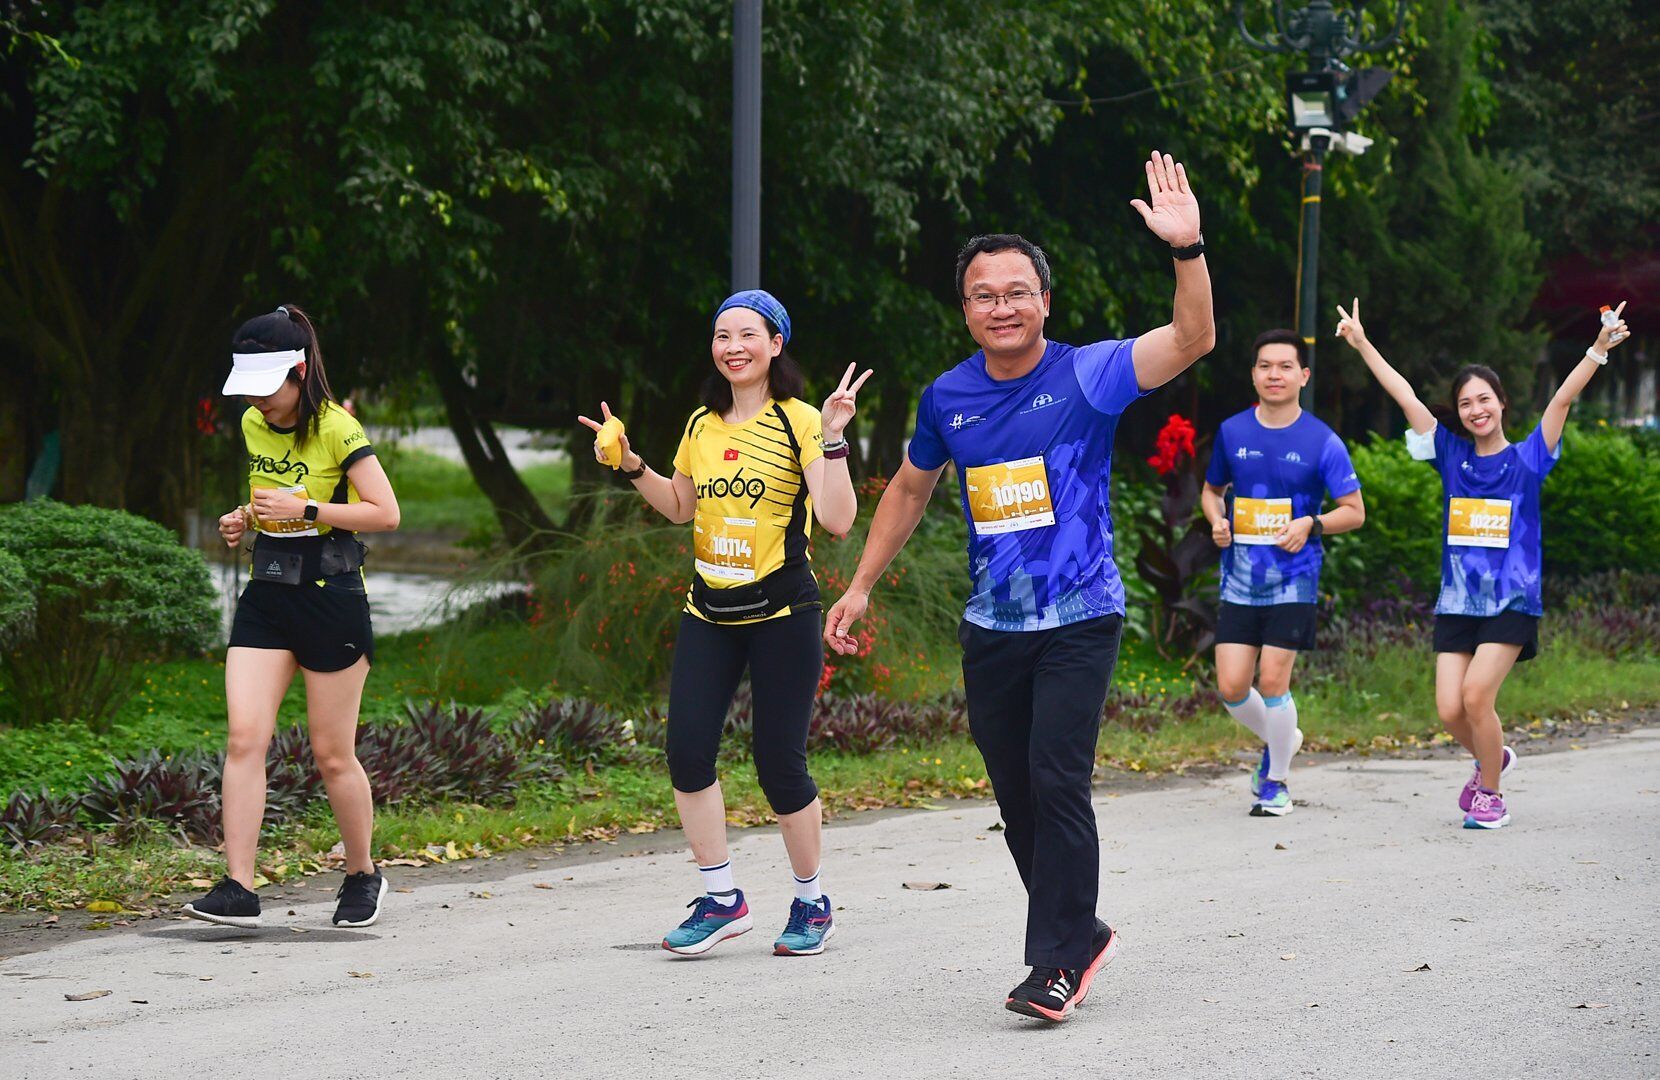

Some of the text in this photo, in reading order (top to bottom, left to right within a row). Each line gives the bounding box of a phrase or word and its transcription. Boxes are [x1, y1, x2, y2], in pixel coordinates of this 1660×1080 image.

[696, 467, 766, 509] trio69
[991, 479, 1046, 507] 10190
[1254, 512, 1291, 528] 10221
[1469, 513, 1508, 529] 10222
[713, 536, 752, 558] 10114
